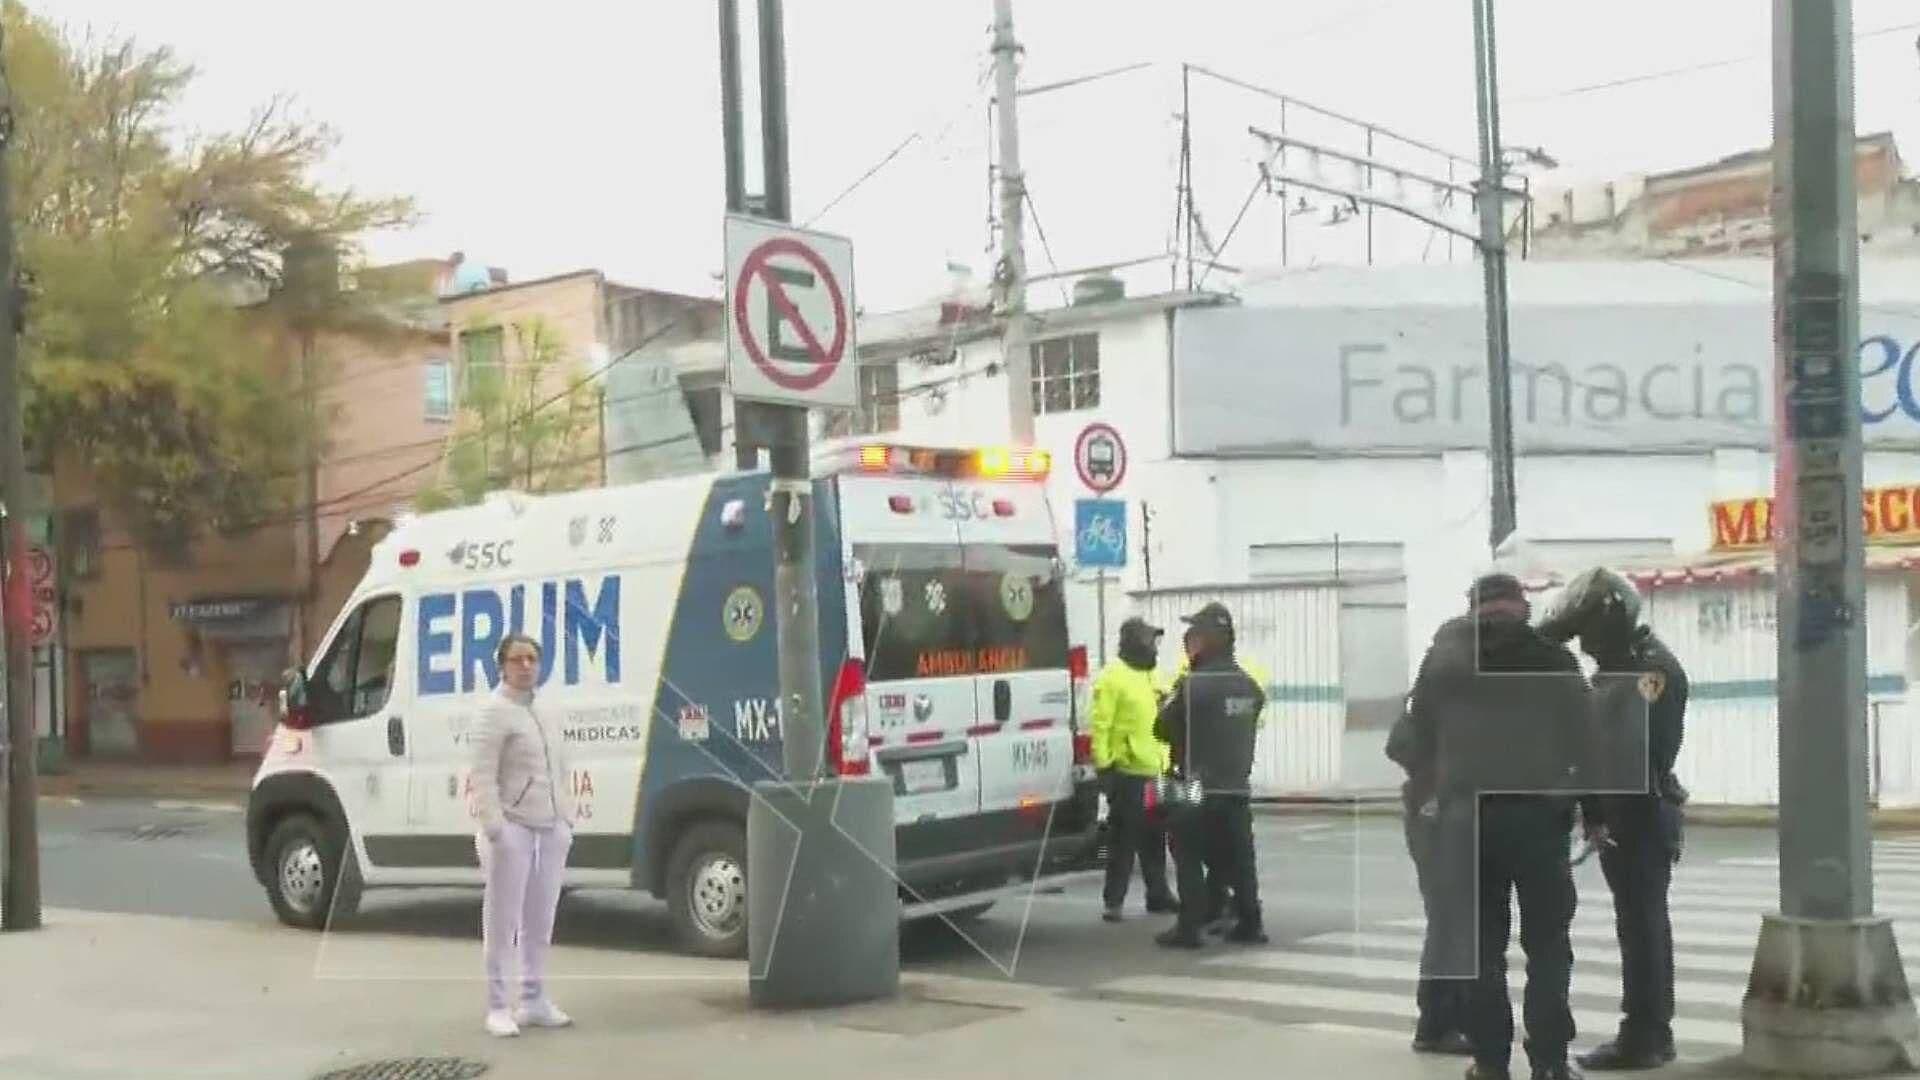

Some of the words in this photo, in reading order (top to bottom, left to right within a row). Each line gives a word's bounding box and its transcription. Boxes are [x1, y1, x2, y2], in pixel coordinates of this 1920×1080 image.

[1338, 342, 1763, 426] Farmacia
[464, 540, 515, 571] SSC
[417, 574, 621, 696] ERUM
[563, 725, 641, 743] MEDICAS
